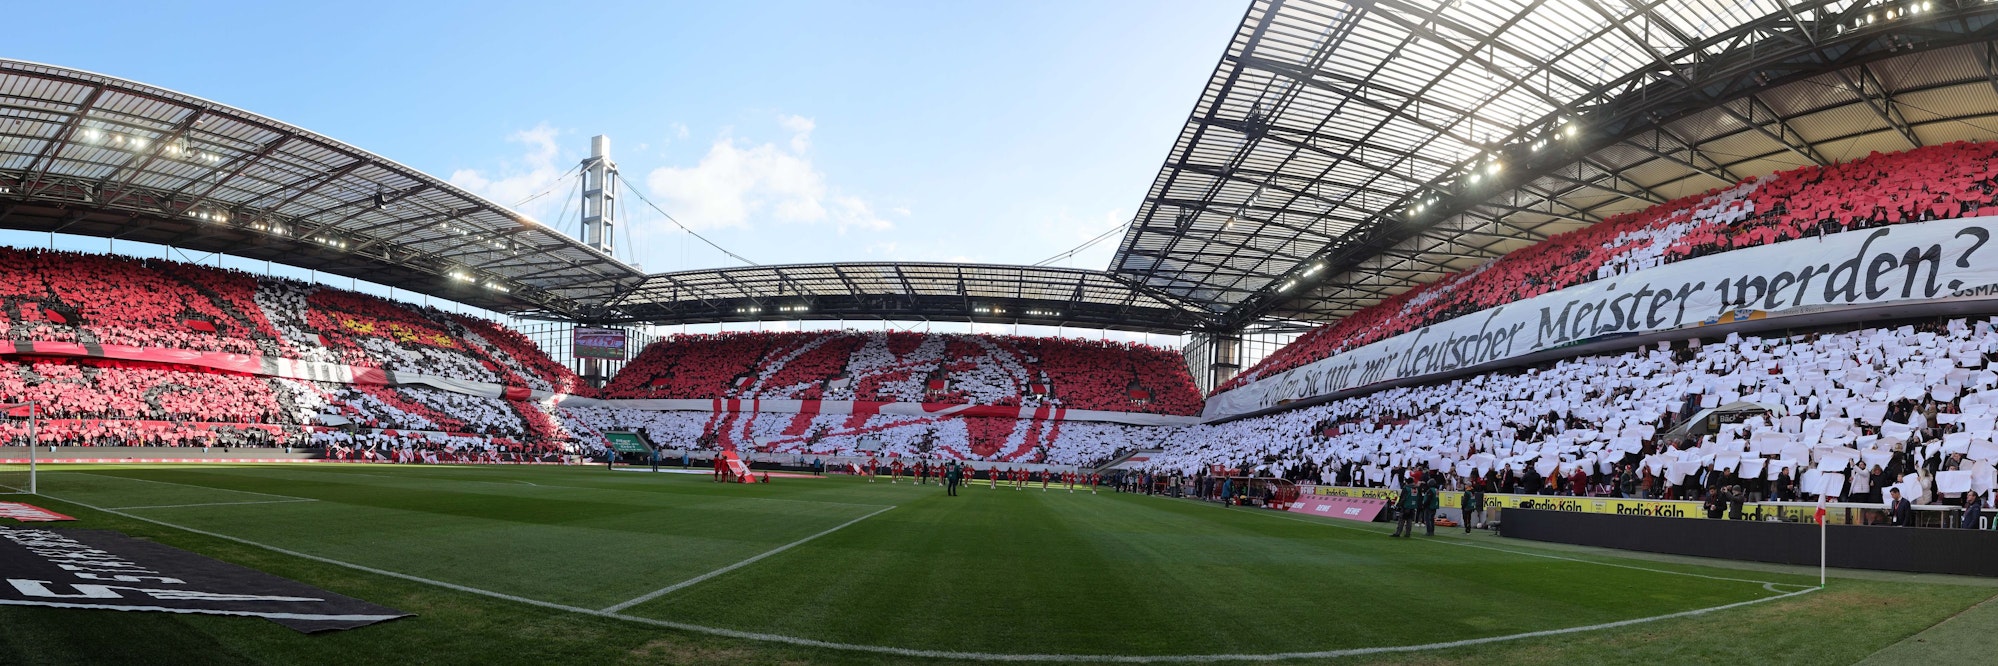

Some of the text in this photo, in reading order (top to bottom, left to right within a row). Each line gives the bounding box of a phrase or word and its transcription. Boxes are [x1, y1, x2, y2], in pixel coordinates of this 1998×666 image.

[1298, 364, 1322, 397] Sie
[1357, 346, 1399, 386] mir
[1396, 306, 1526, 377] deutscher
[1531, 281, 1706, 351] Meister
[1714, 226, 1990, 315] werden?
[1291, 501, 1306, 509] REWE
[1315, 504, 1332, 512] REWE
[1529, 499, 1557, 510] Radio
[1560, 500, 1582, 512] Köln
[1617, 503, 1652, 515] Radio
[1655, 504, 1684, 517] Köln
[1344, 507, 1361, 515] REWE
